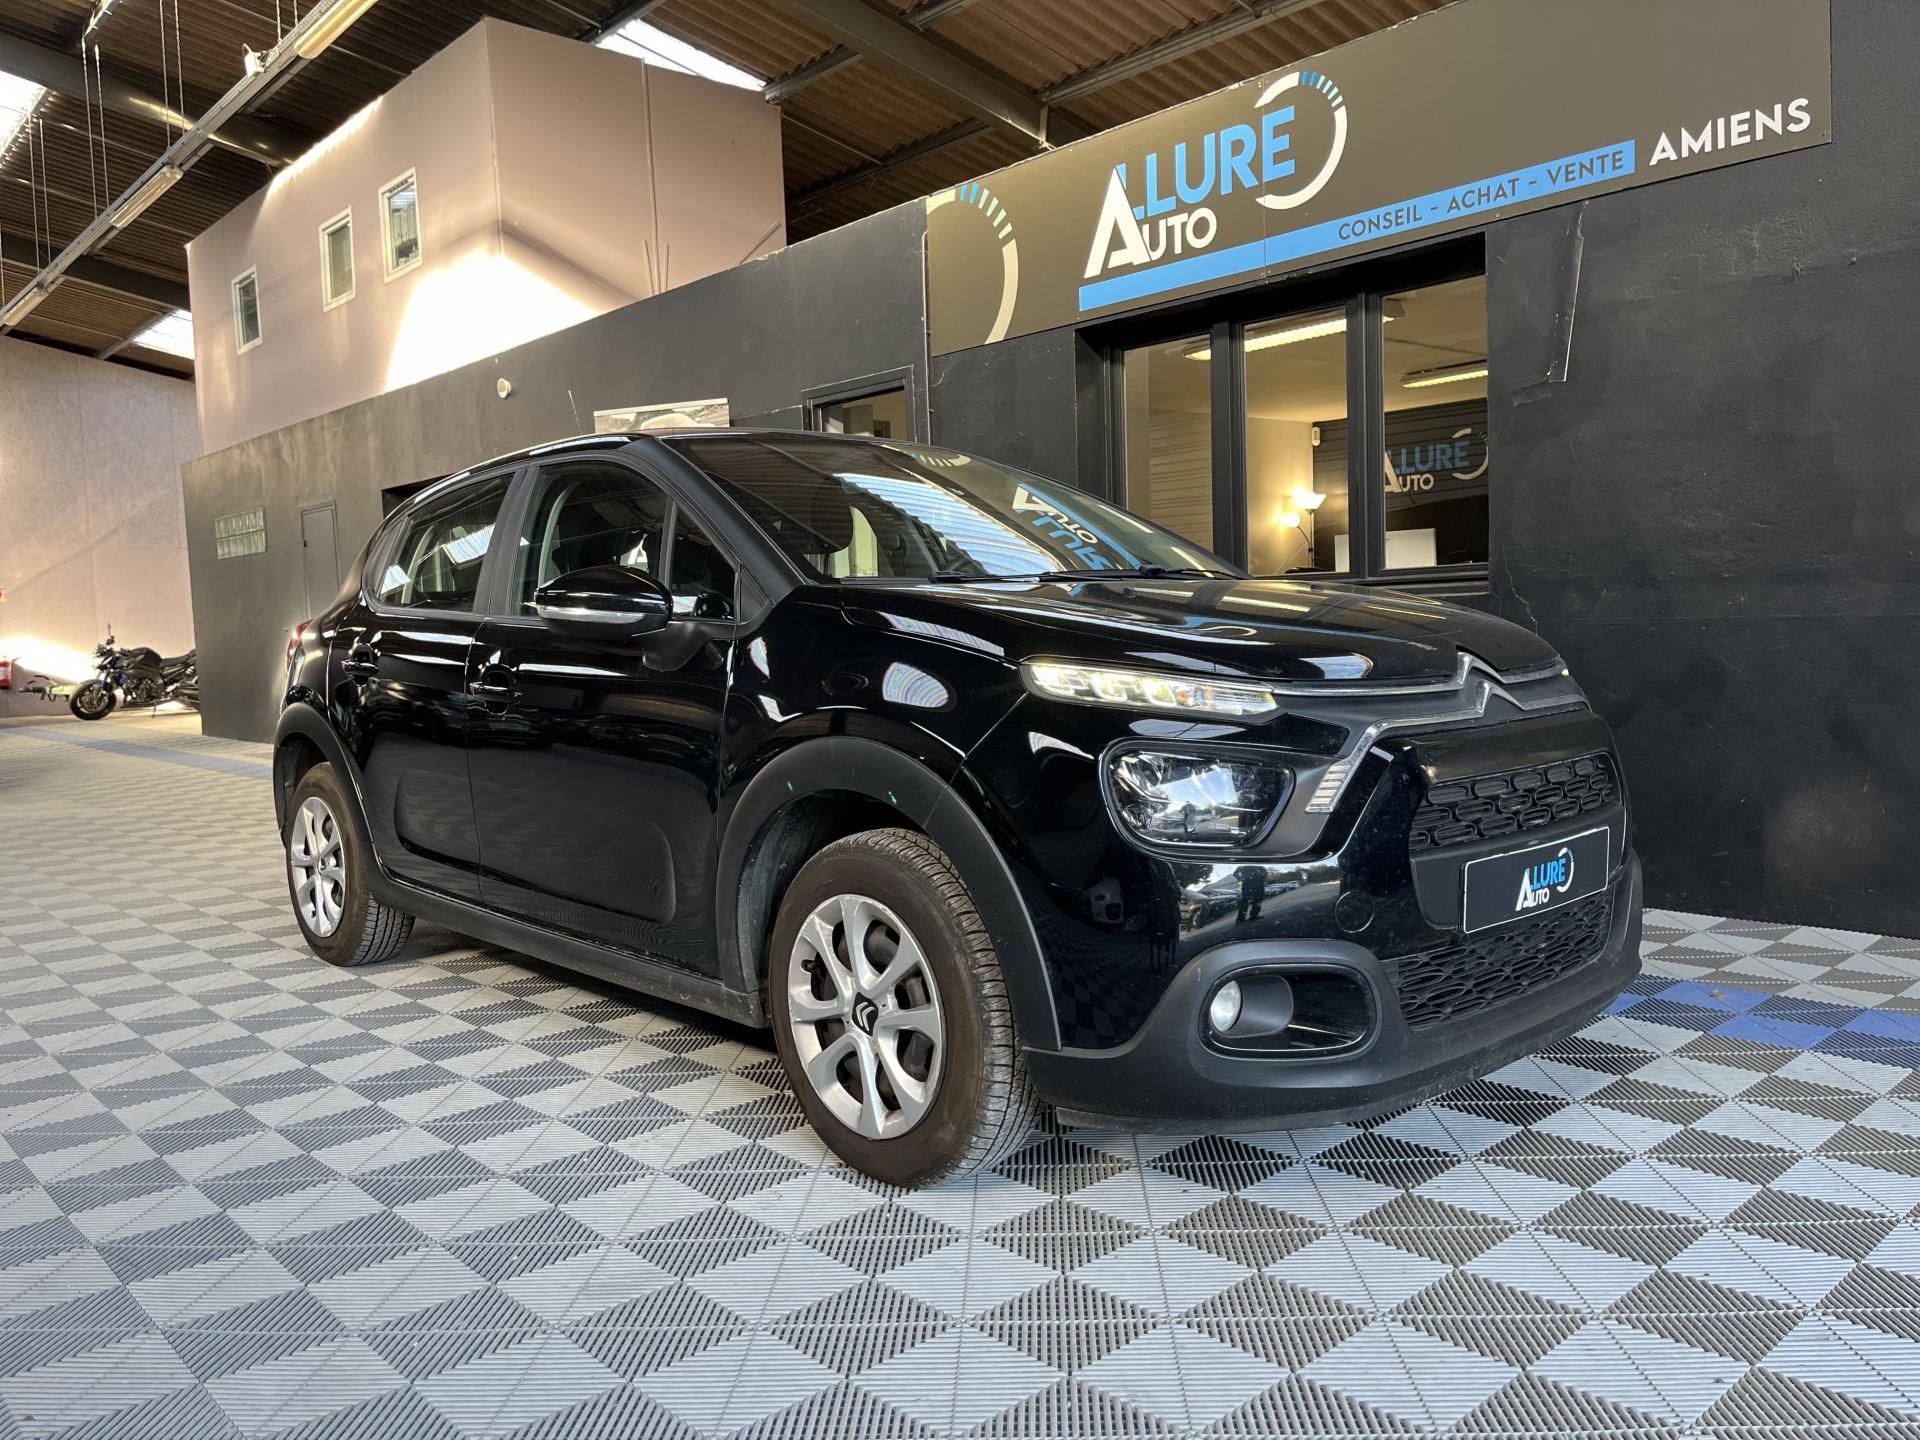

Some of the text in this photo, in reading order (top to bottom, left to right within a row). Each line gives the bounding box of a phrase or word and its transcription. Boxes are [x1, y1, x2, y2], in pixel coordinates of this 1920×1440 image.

[1649, 98, 1811, 166] AMIENS
[1084, 167, 1217, 279] AUTO
[1338, 205, 1423, 240] CONSEIL
[1447, 178, 1520, 214] ACHAT
[1546, 150, 1624, 186] VENTE
[1384, 451, 1434, 493] AUTO
[1515, 857, 1566, 912] ALURE
[1515, 868, 1549, 912] AUTO
